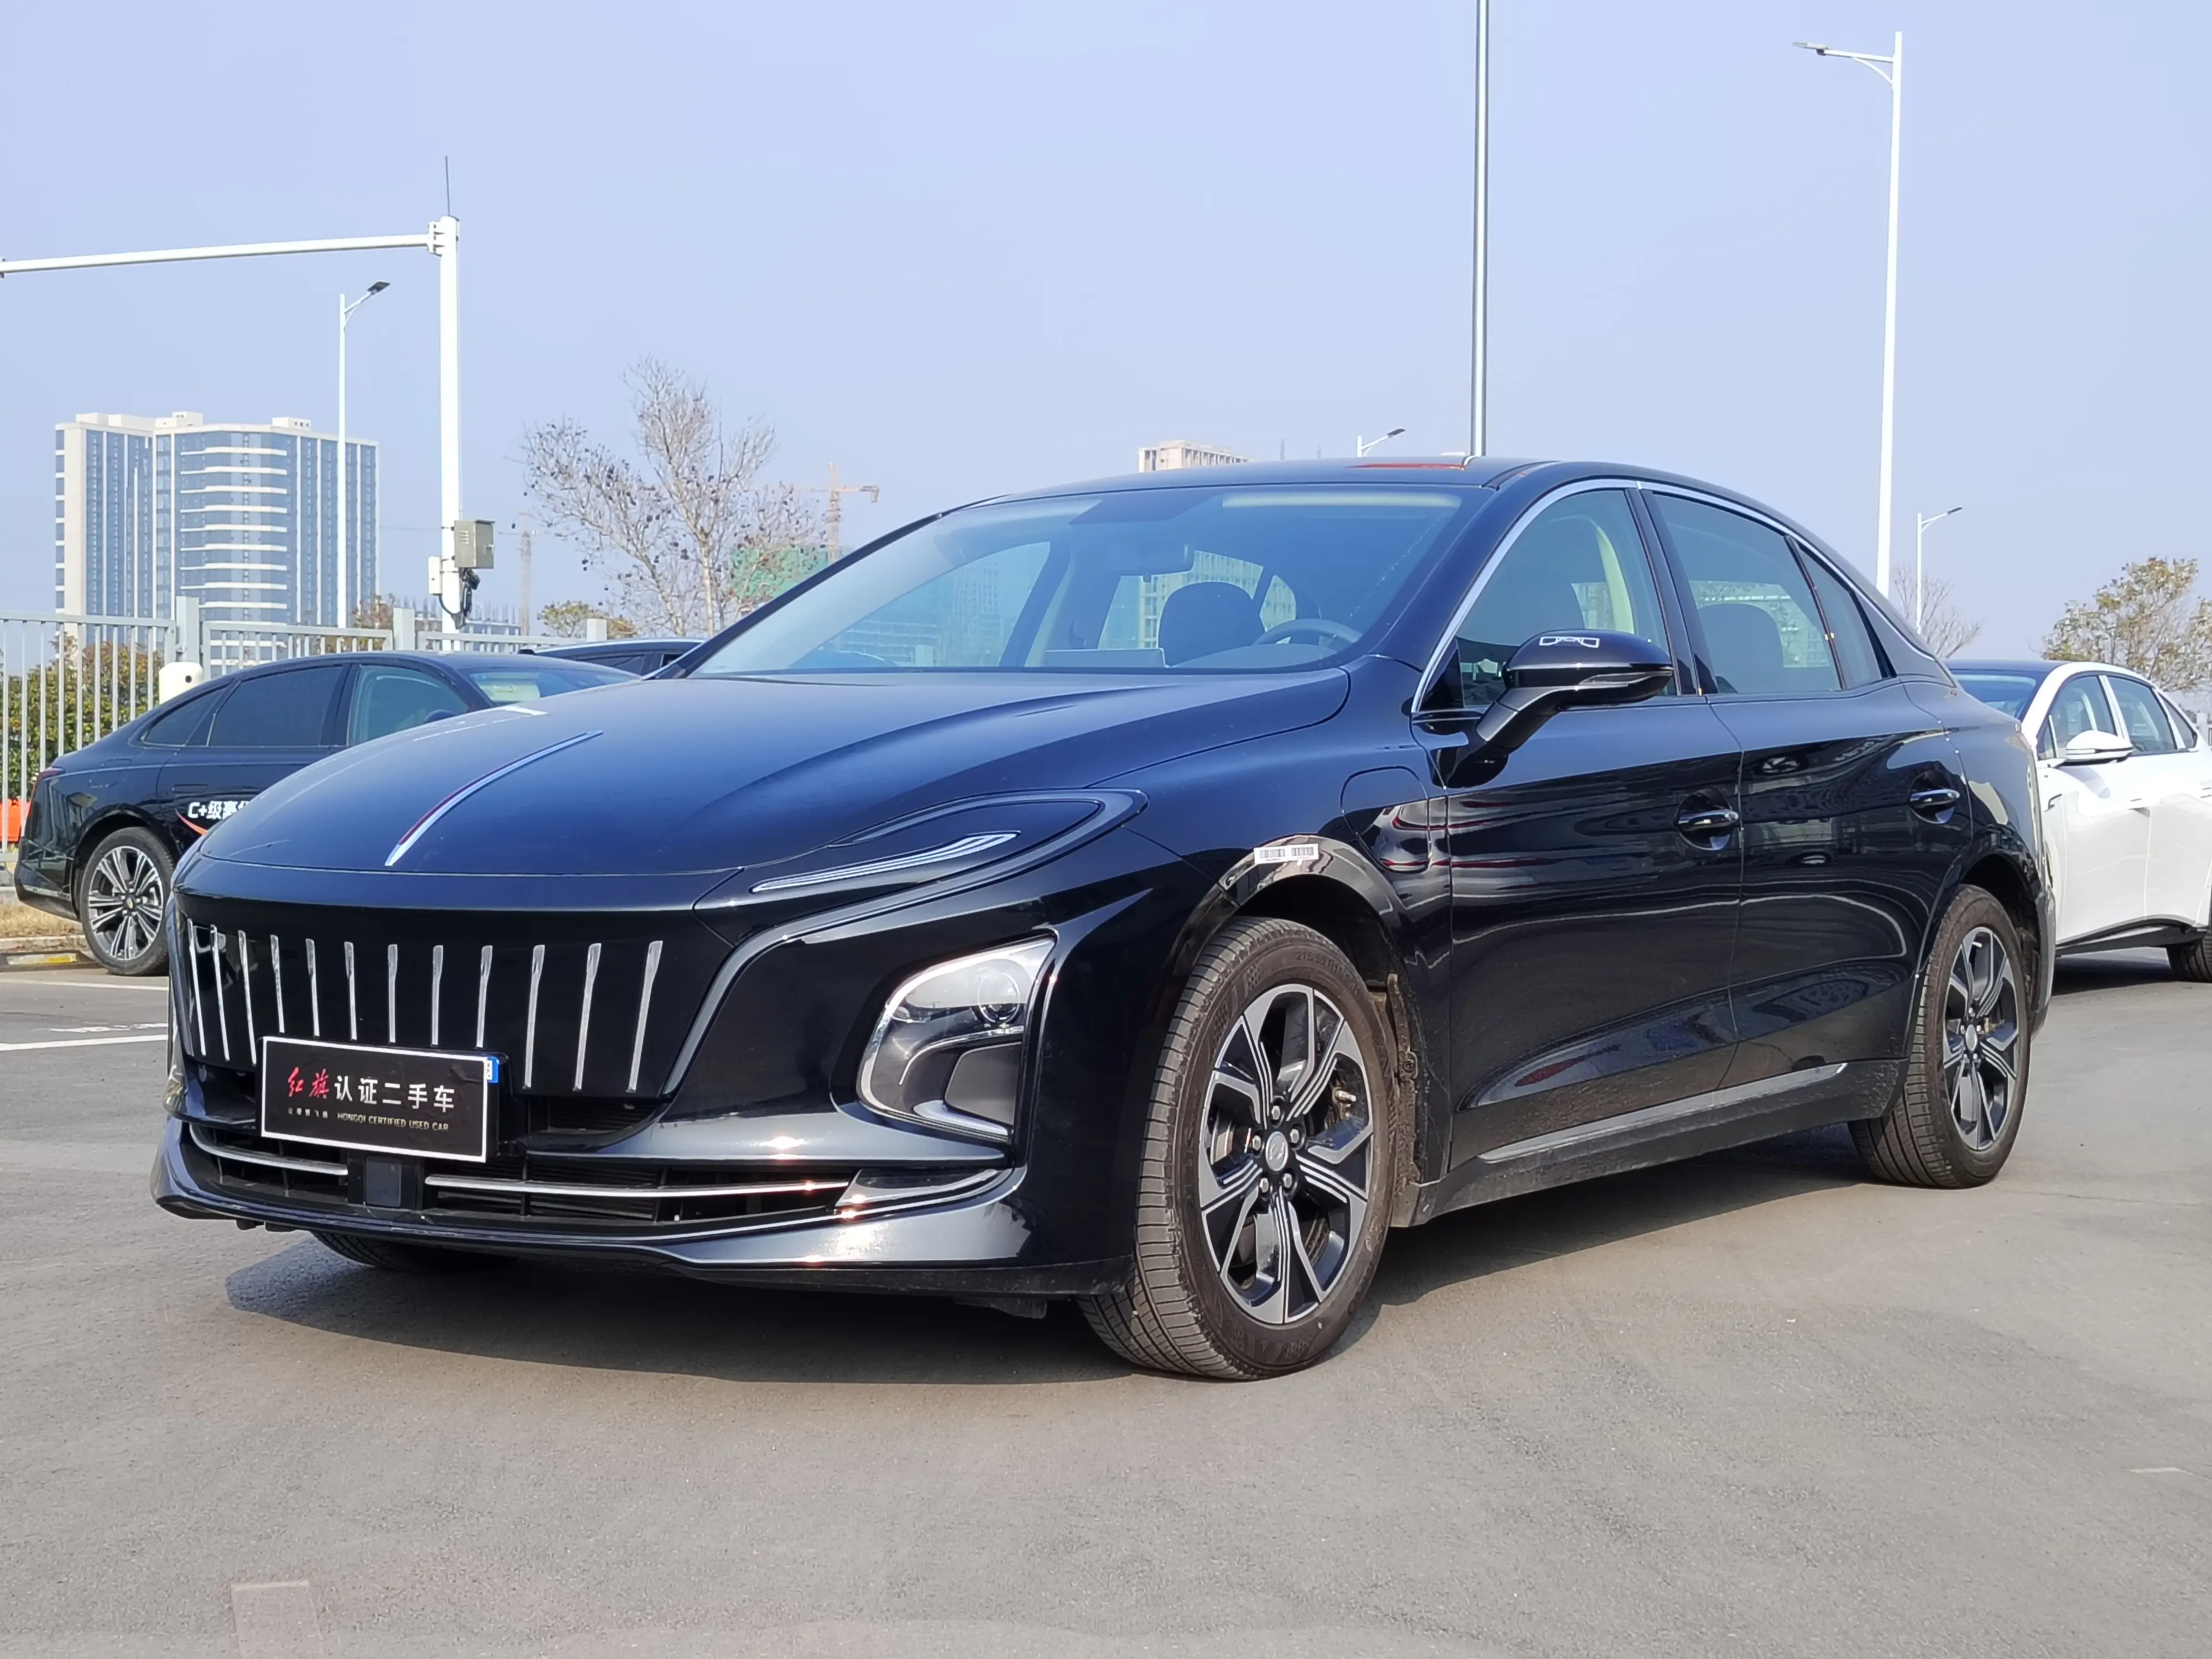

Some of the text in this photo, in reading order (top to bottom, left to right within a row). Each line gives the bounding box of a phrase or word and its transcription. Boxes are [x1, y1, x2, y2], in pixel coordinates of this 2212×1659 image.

[368, 1115, 406, 1128] CERTIFIED
[409, 1119, 430, 1130] USED
[432, 1122, 449, 1132] CAR
